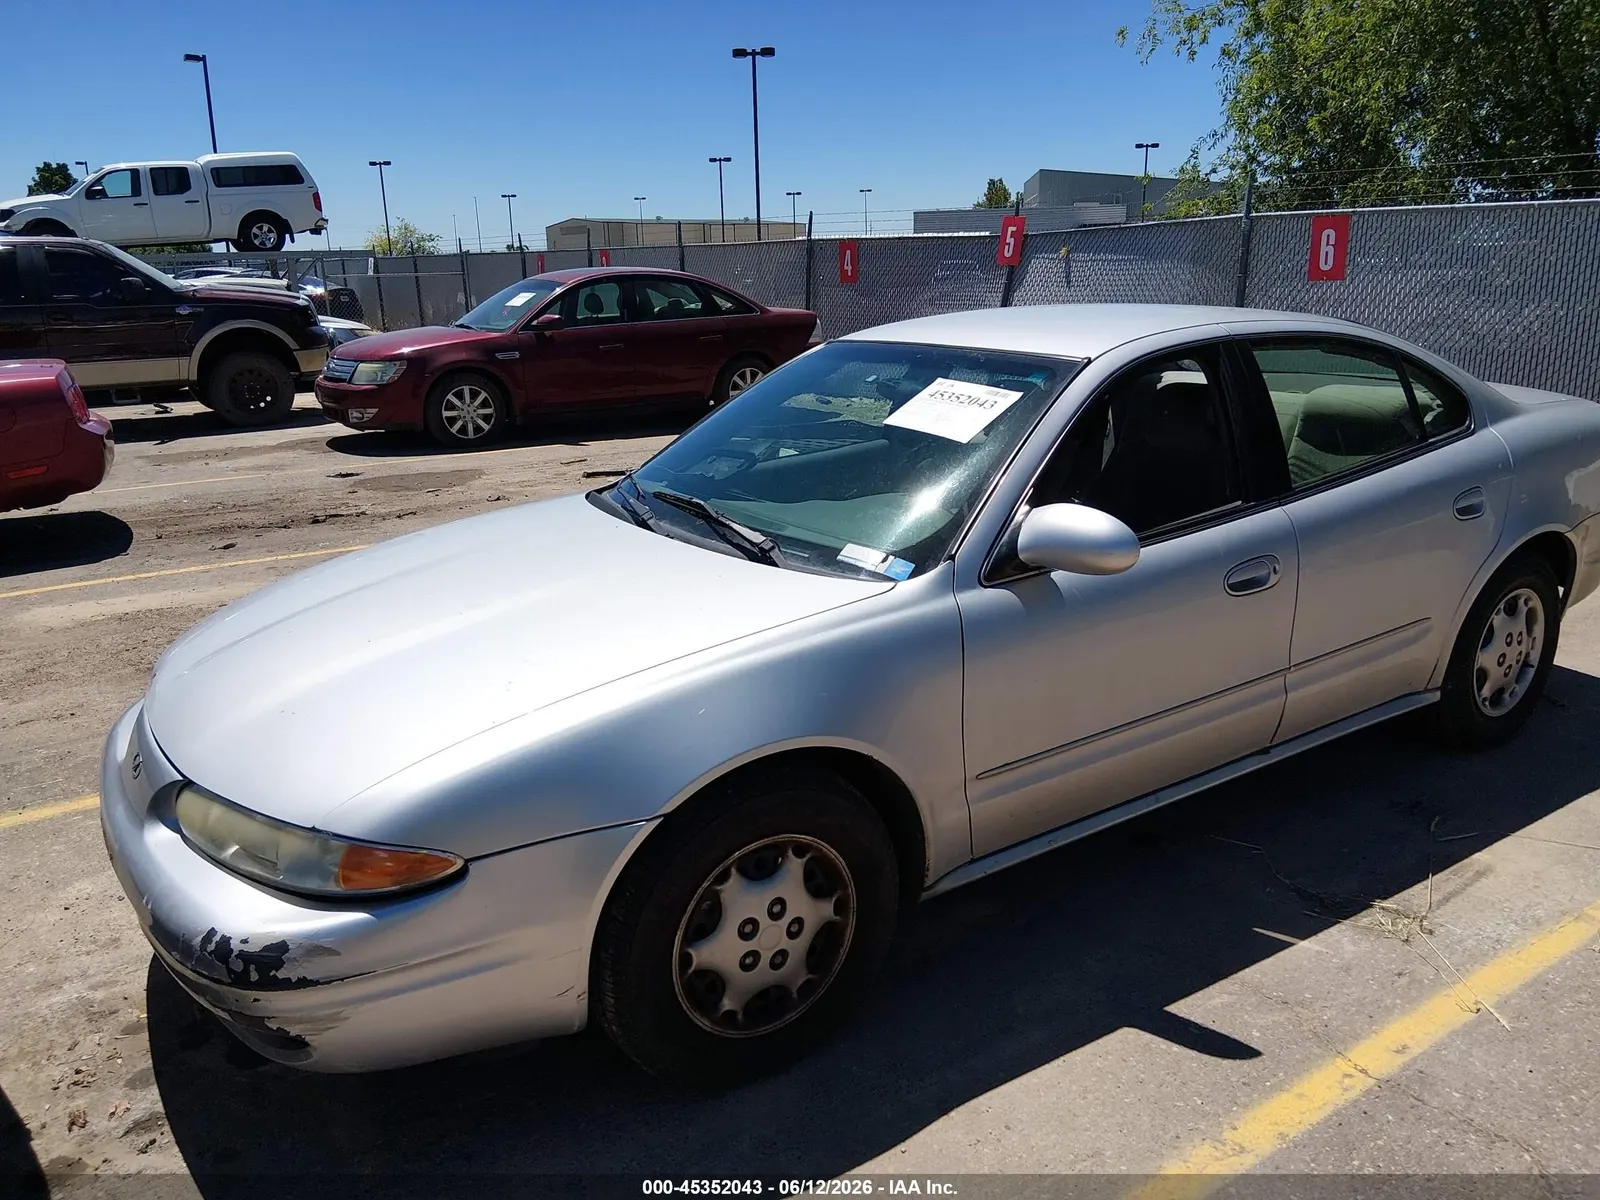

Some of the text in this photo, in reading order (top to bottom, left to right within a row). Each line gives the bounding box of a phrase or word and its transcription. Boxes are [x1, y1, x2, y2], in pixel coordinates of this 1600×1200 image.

[1004, 226, 1017, 258] 5
[1319, 228, 1336, 271] 6
[844, 250, 852, 276] 4
[928, 390, 998, 410] 45352043
